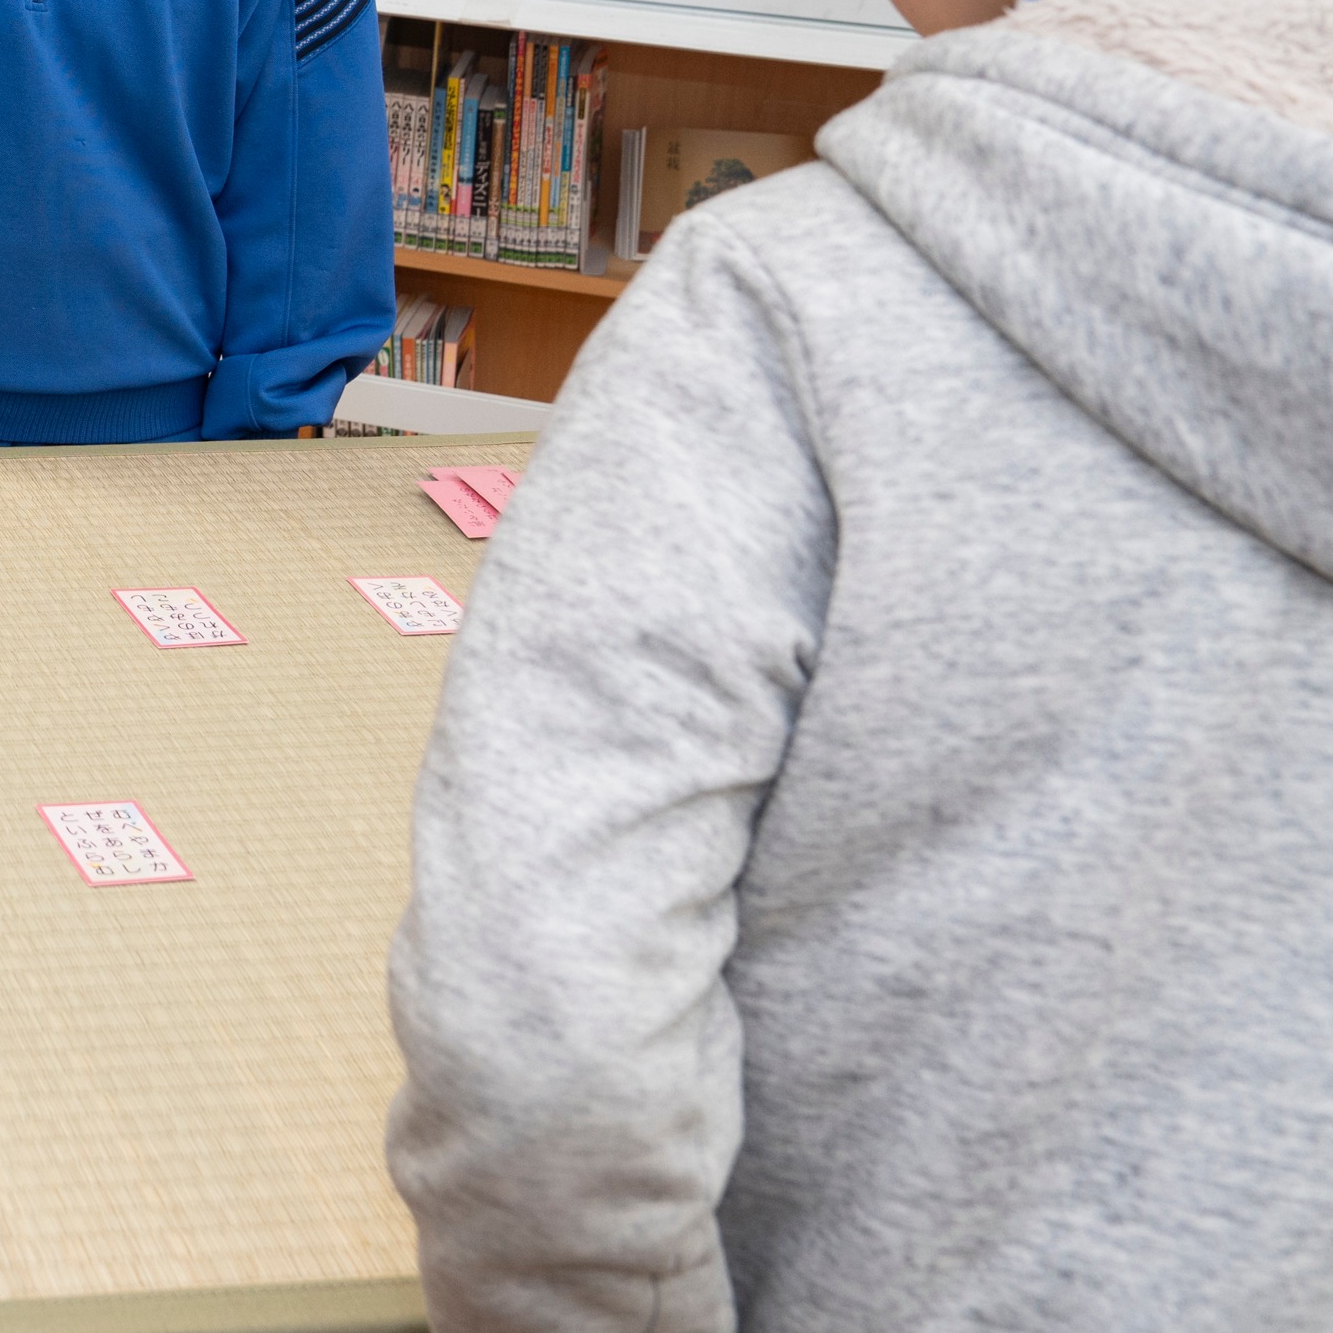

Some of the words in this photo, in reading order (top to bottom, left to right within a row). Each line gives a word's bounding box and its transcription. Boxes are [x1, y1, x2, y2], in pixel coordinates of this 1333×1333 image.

[131, 595, 181, 642] やくやもし
[367, 582, 423, 628] やまのおく
[60, 812, 114, 876] といふらむ
